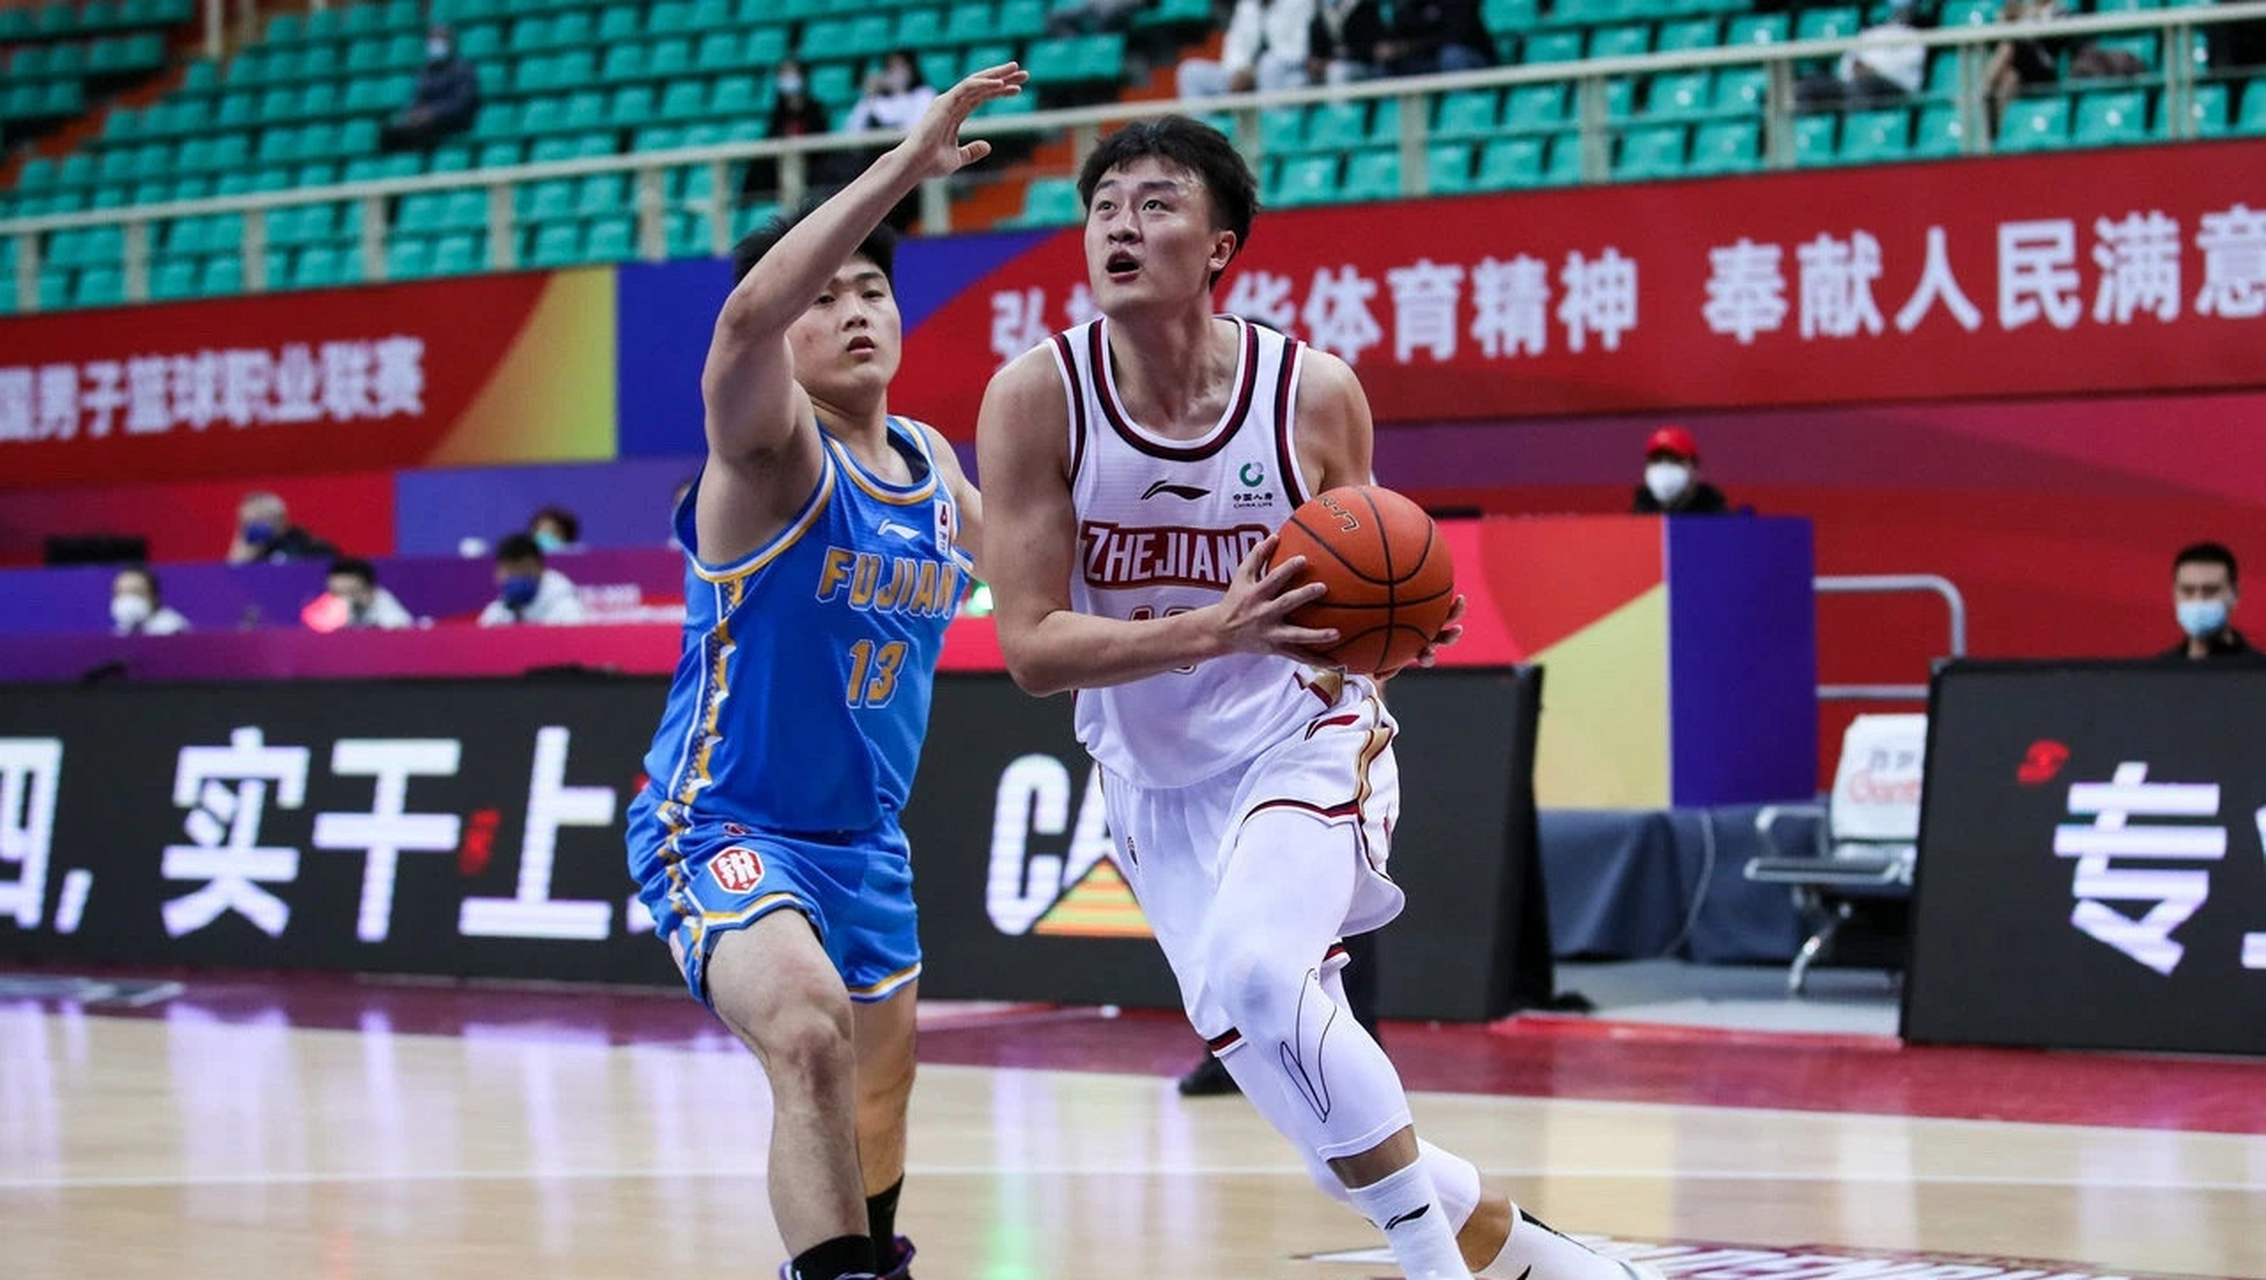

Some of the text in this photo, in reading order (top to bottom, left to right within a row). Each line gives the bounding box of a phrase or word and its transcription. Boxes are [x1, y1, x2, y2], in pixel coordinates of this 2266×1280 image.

[815, 545, 958, 620] FUJIAN
[846, 639, 909, 709] 13
[2053, 761, 2266, 976] 专
